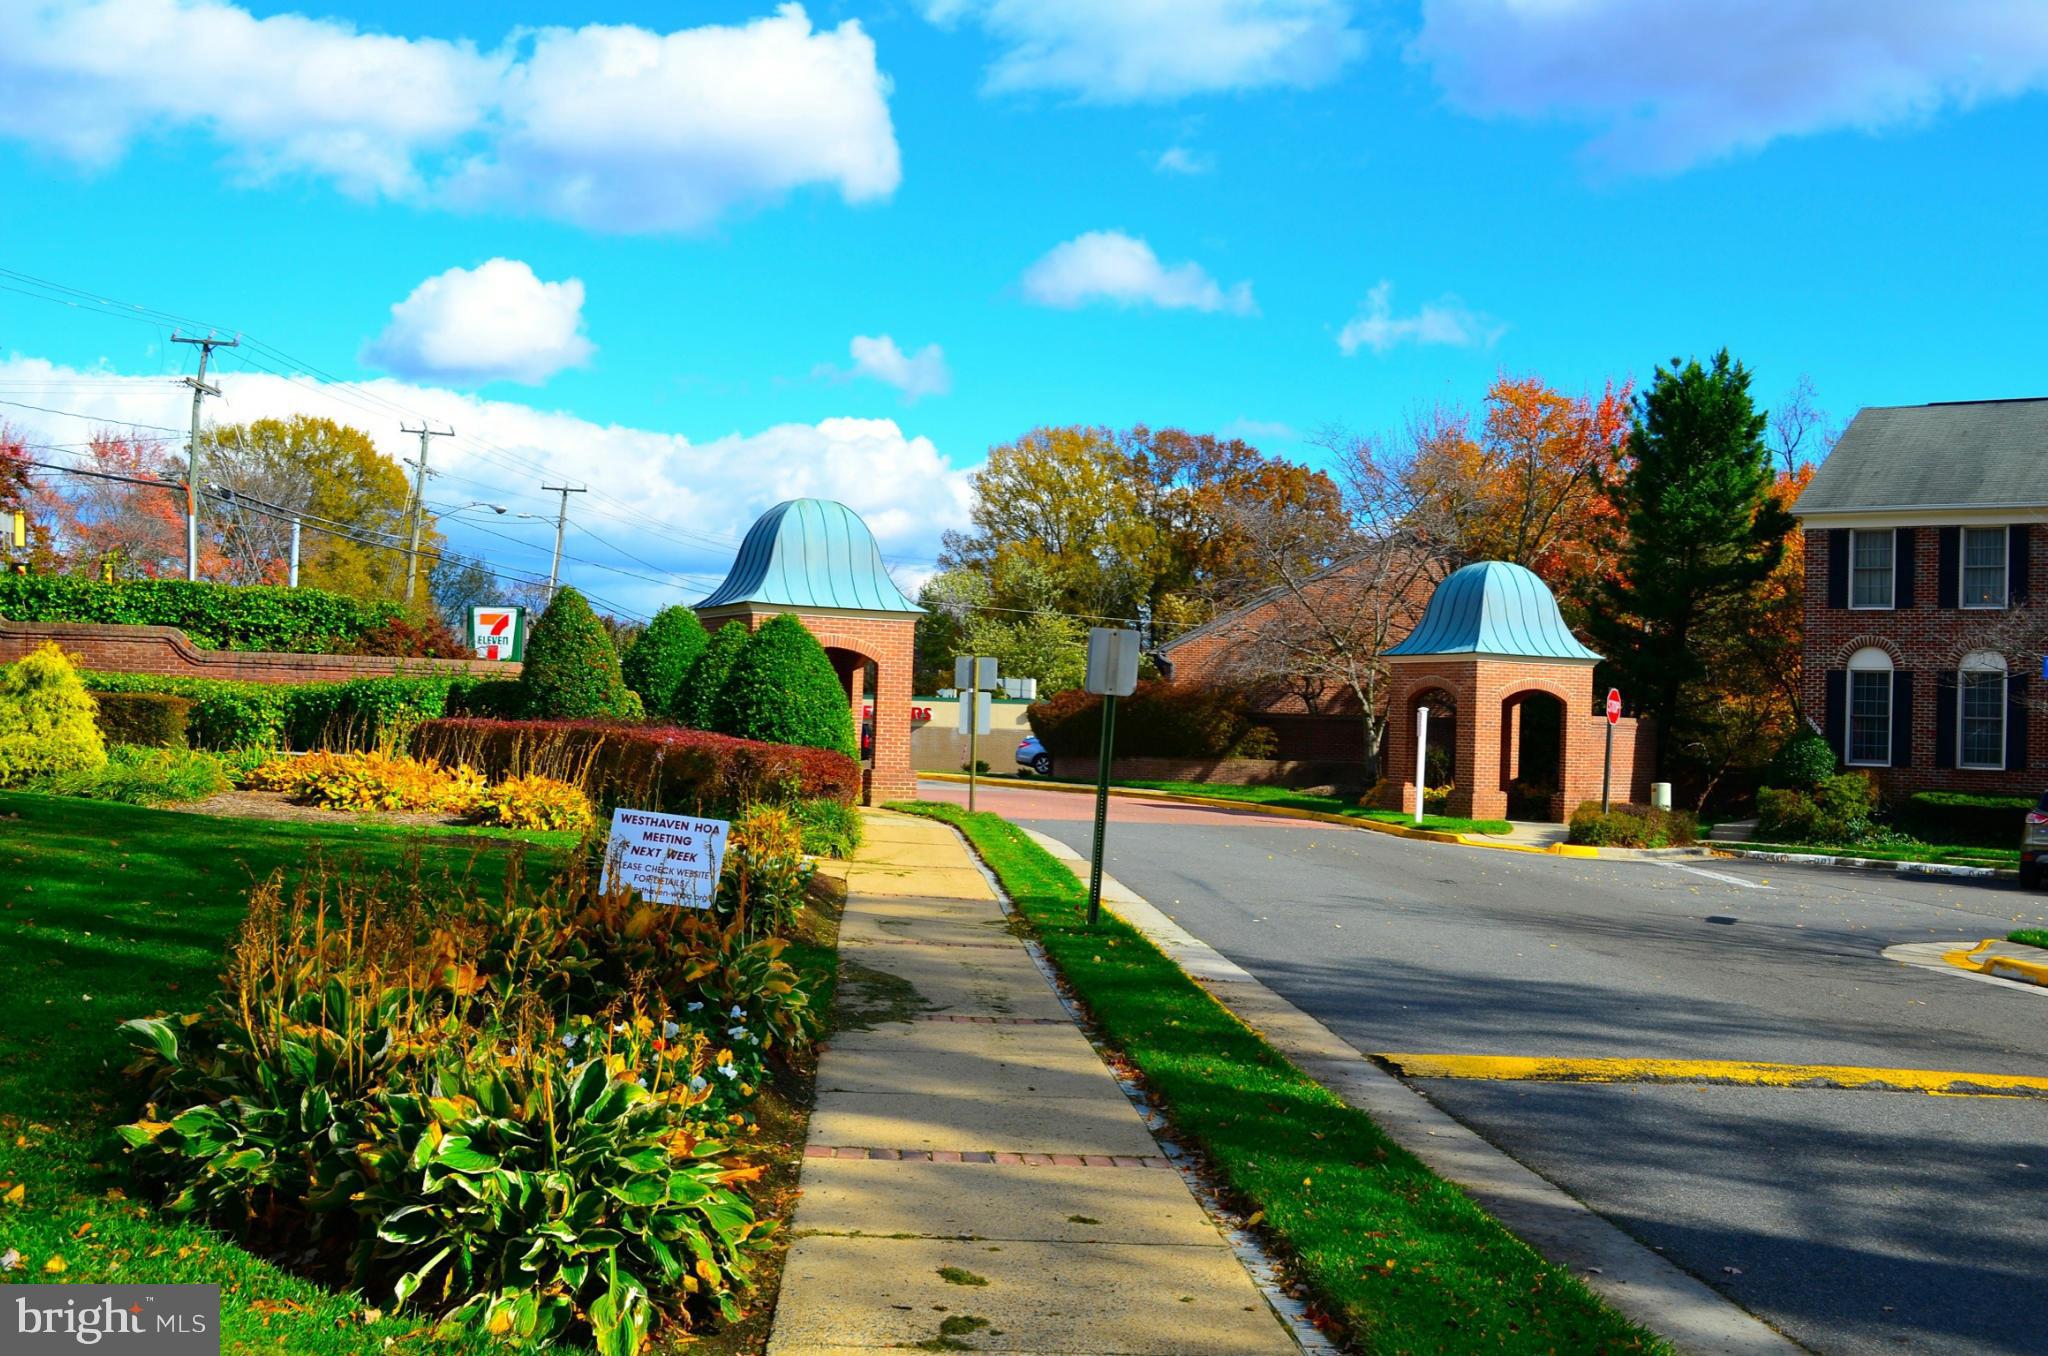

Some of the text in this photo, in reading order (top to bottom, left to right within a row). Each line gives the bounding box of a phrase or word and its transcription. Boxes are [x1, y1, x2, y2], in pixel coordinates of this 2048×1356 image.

[621, 813, 720, 834] WESTHAVEN HOA
[642, 831, 692, 846] MEETING
[630, 845, 699, 863] NEXT WEEK
[644, 864, 674, 876] CHECK
[676, 867, 710, 880] WEBSITE
